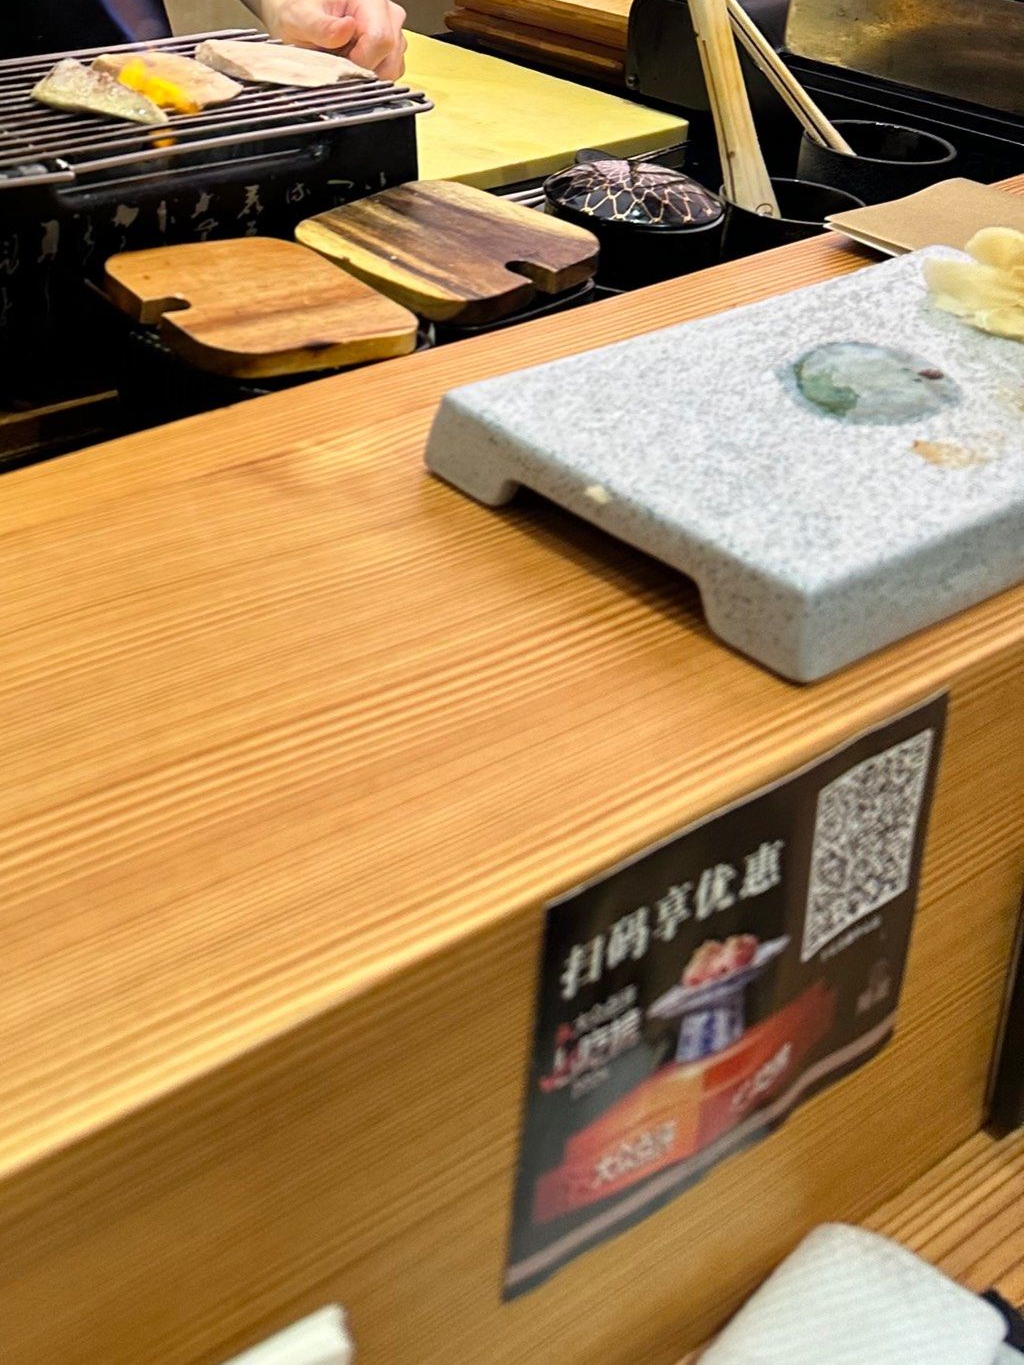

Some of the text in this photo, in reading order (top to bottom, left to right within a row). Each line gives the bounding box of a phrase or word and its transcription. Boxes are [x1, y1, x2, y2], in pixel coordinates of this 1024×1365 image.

[560, 839, 785, 1000] 扫码享优惠
